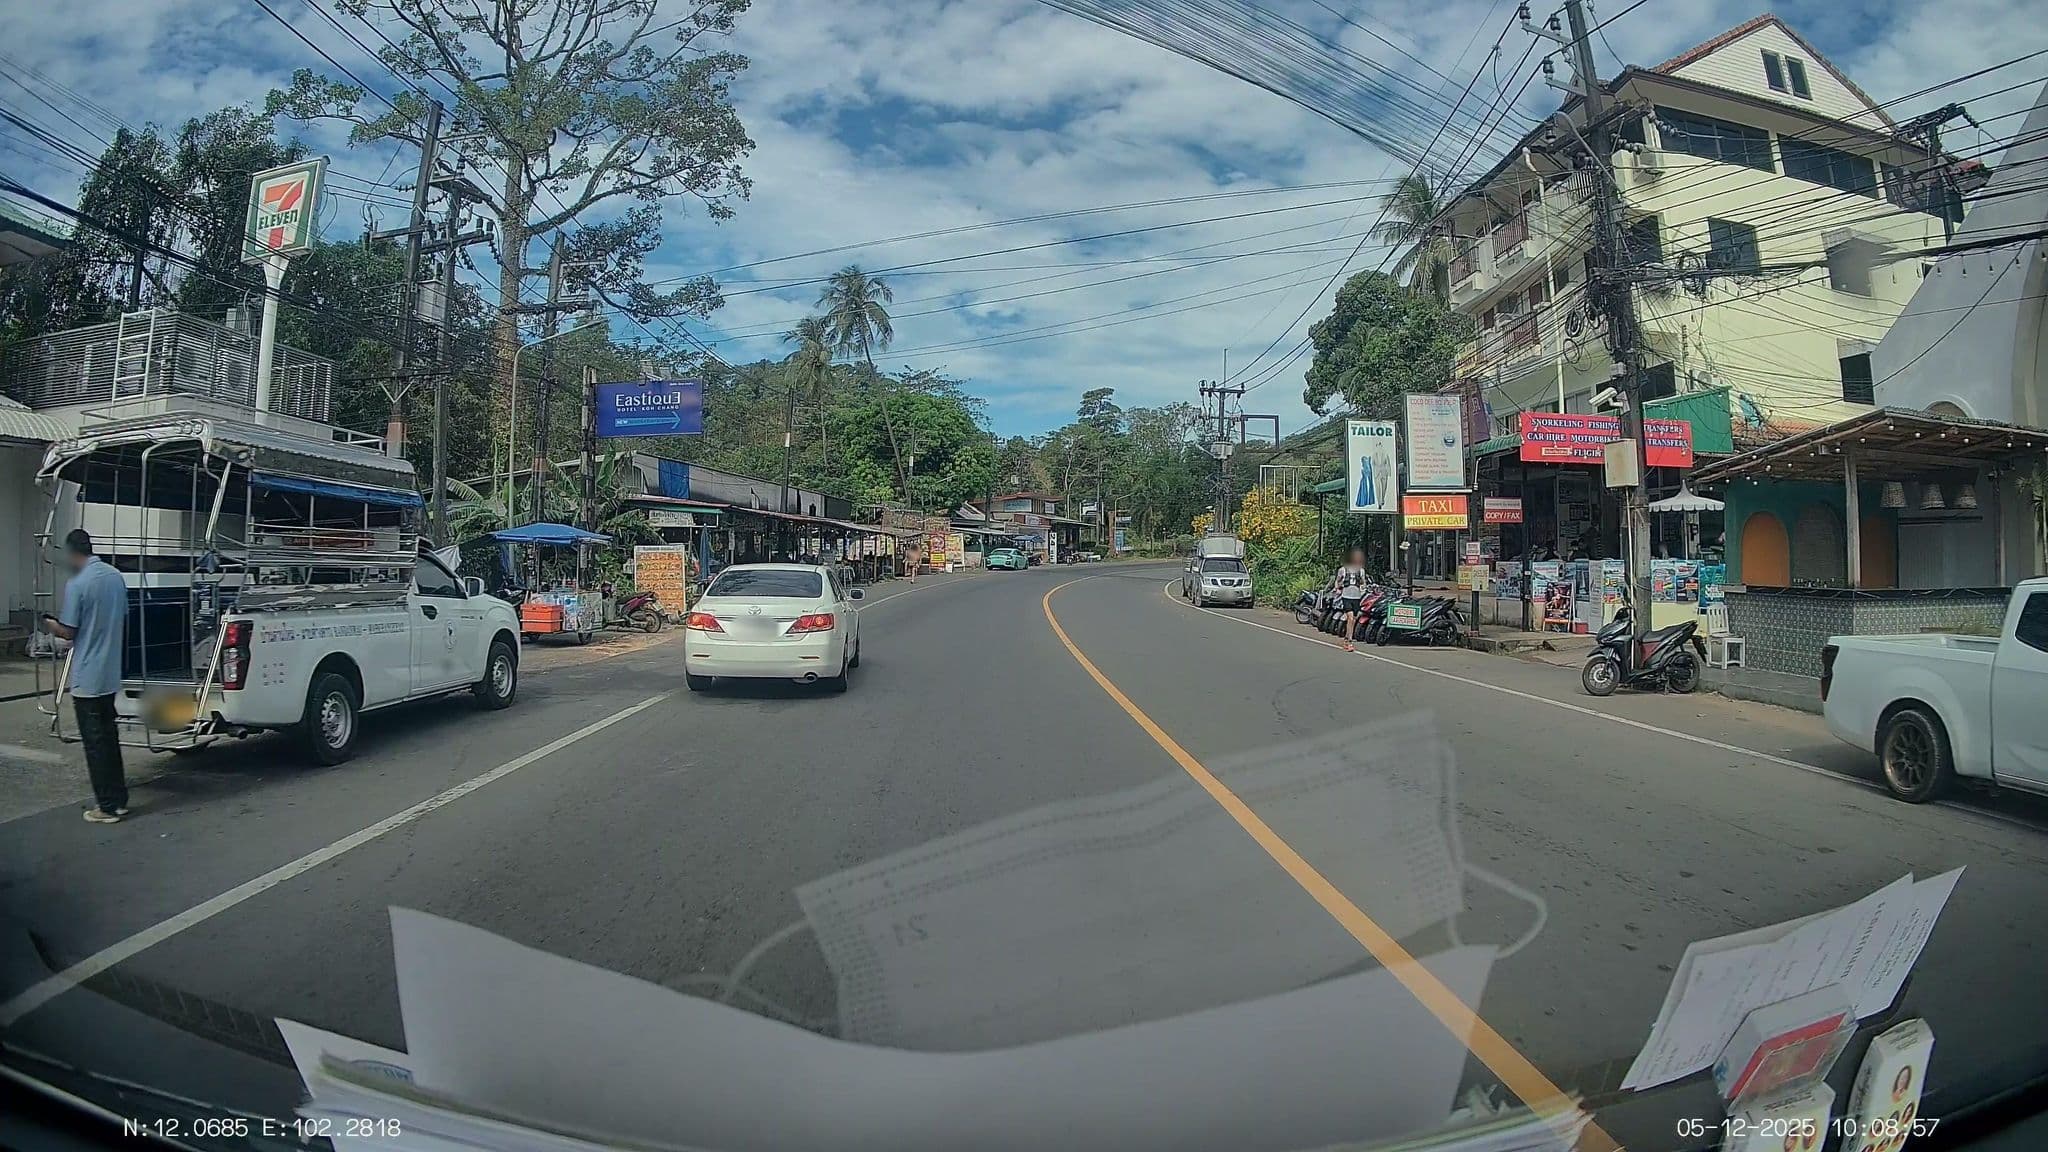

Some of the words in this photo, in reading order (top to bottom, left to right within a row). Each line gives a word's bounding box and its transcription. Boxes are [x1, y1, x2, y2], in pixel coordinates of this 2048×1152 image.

[1531, 418, 1584, 428] SNORKELING
[1588, 421, 1619, 430] FISHING
[1351, 426, 1393, 437] TAILOR
[1527, 432, 1544, 440] CAR
[1546, 433, 1566, 441] HIRE
[1647, 438, 1689, 447] TRANSFERS
[1419, 500, 1453, 513] TAXI
[1407, 517, 1443, 525] PRIVATE
[1447, 517, 1465, 525] CAR
